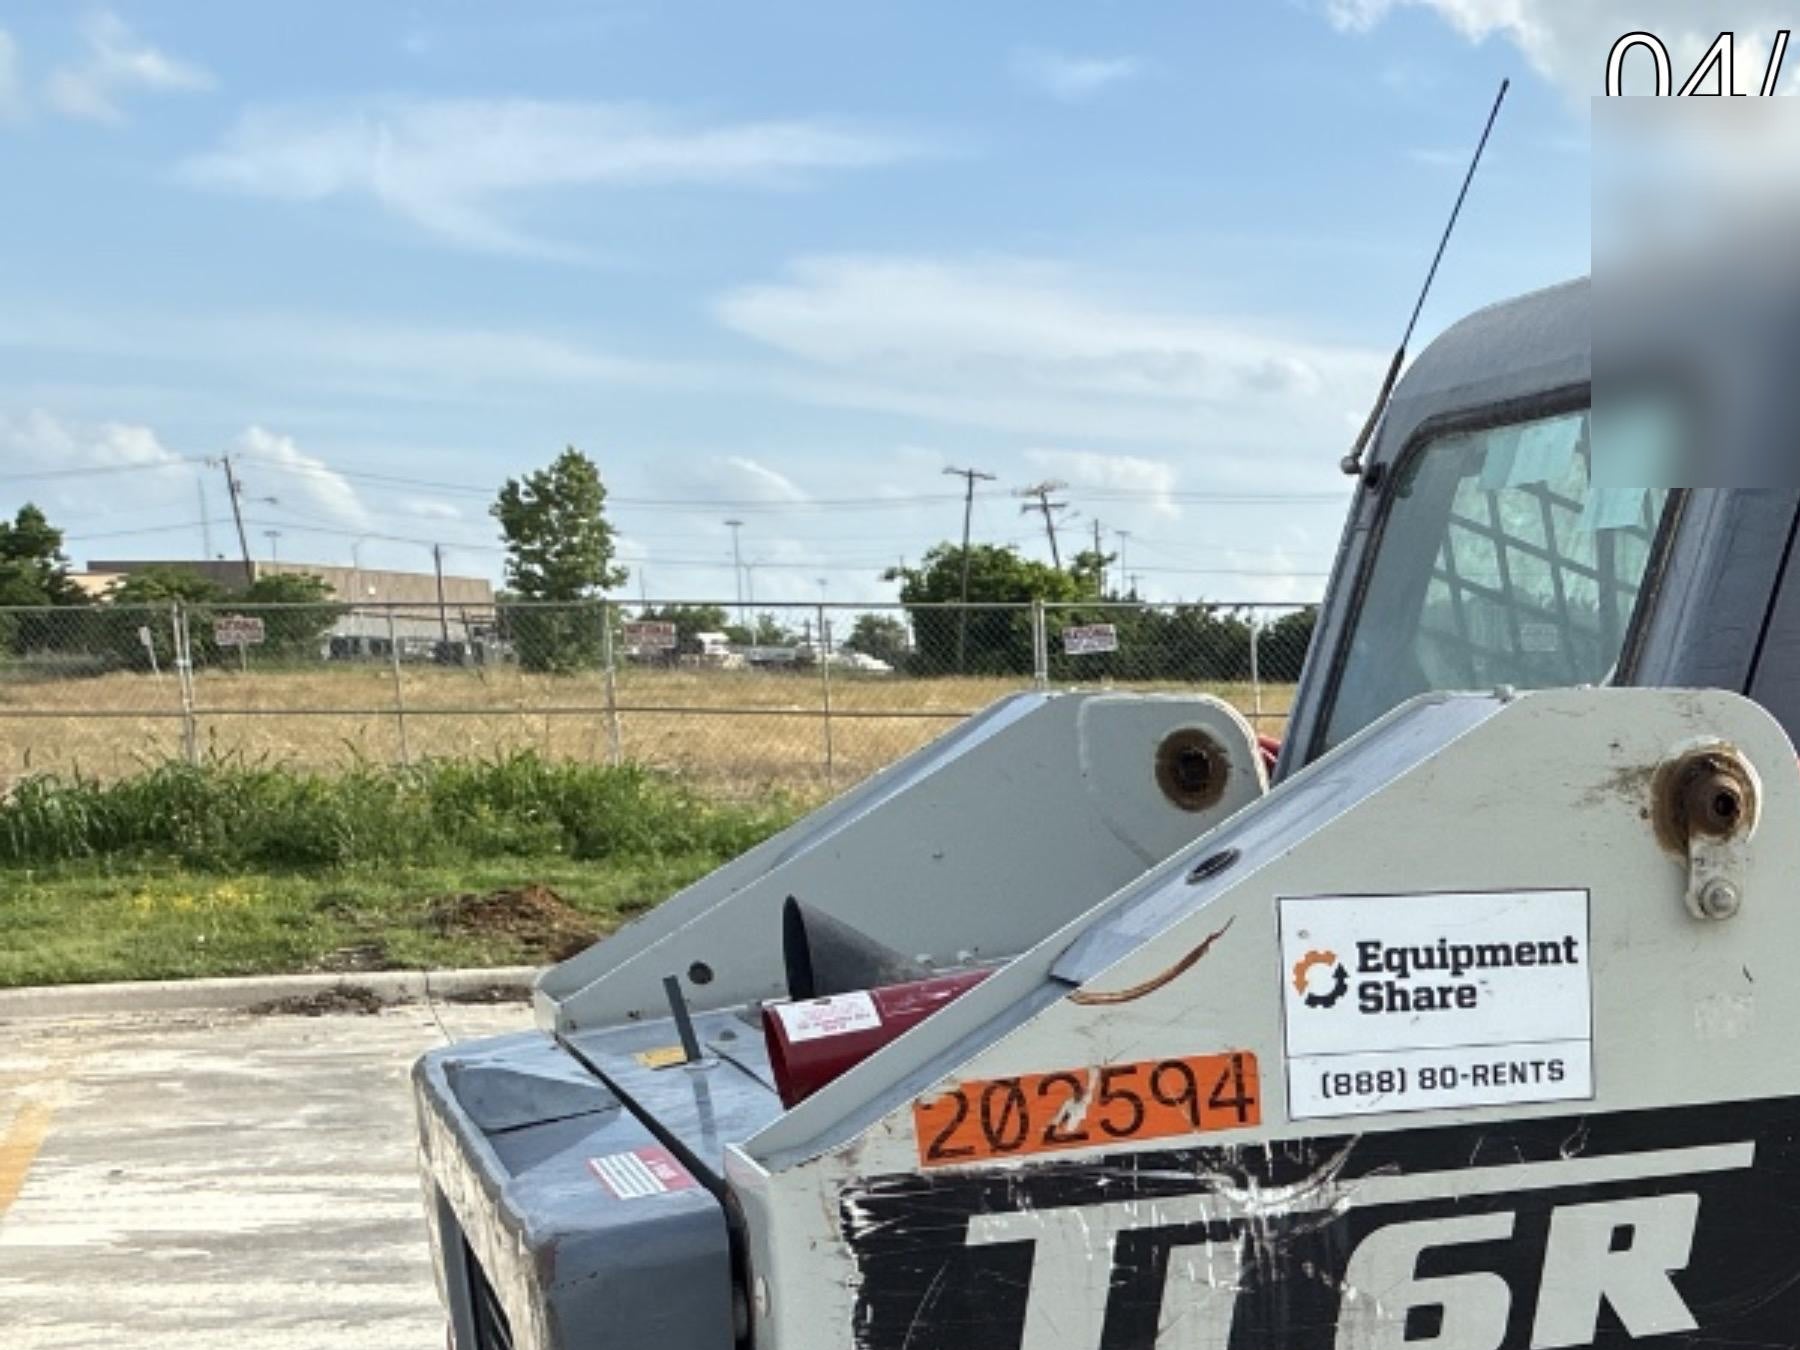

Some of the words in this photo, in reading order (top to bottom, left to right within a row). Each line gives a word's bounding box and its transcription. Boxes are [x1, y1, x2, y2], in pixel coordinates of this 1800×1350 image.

[1356, 935, 1579, 978] Equipment
[1357, 980, 1478, 1014] Share
[1321, 1067, 1407, 1098] (888)
[1417, 1058, 1566, 1090] 80-RENTS
[921, 1052, 1256, 1161] 202594
